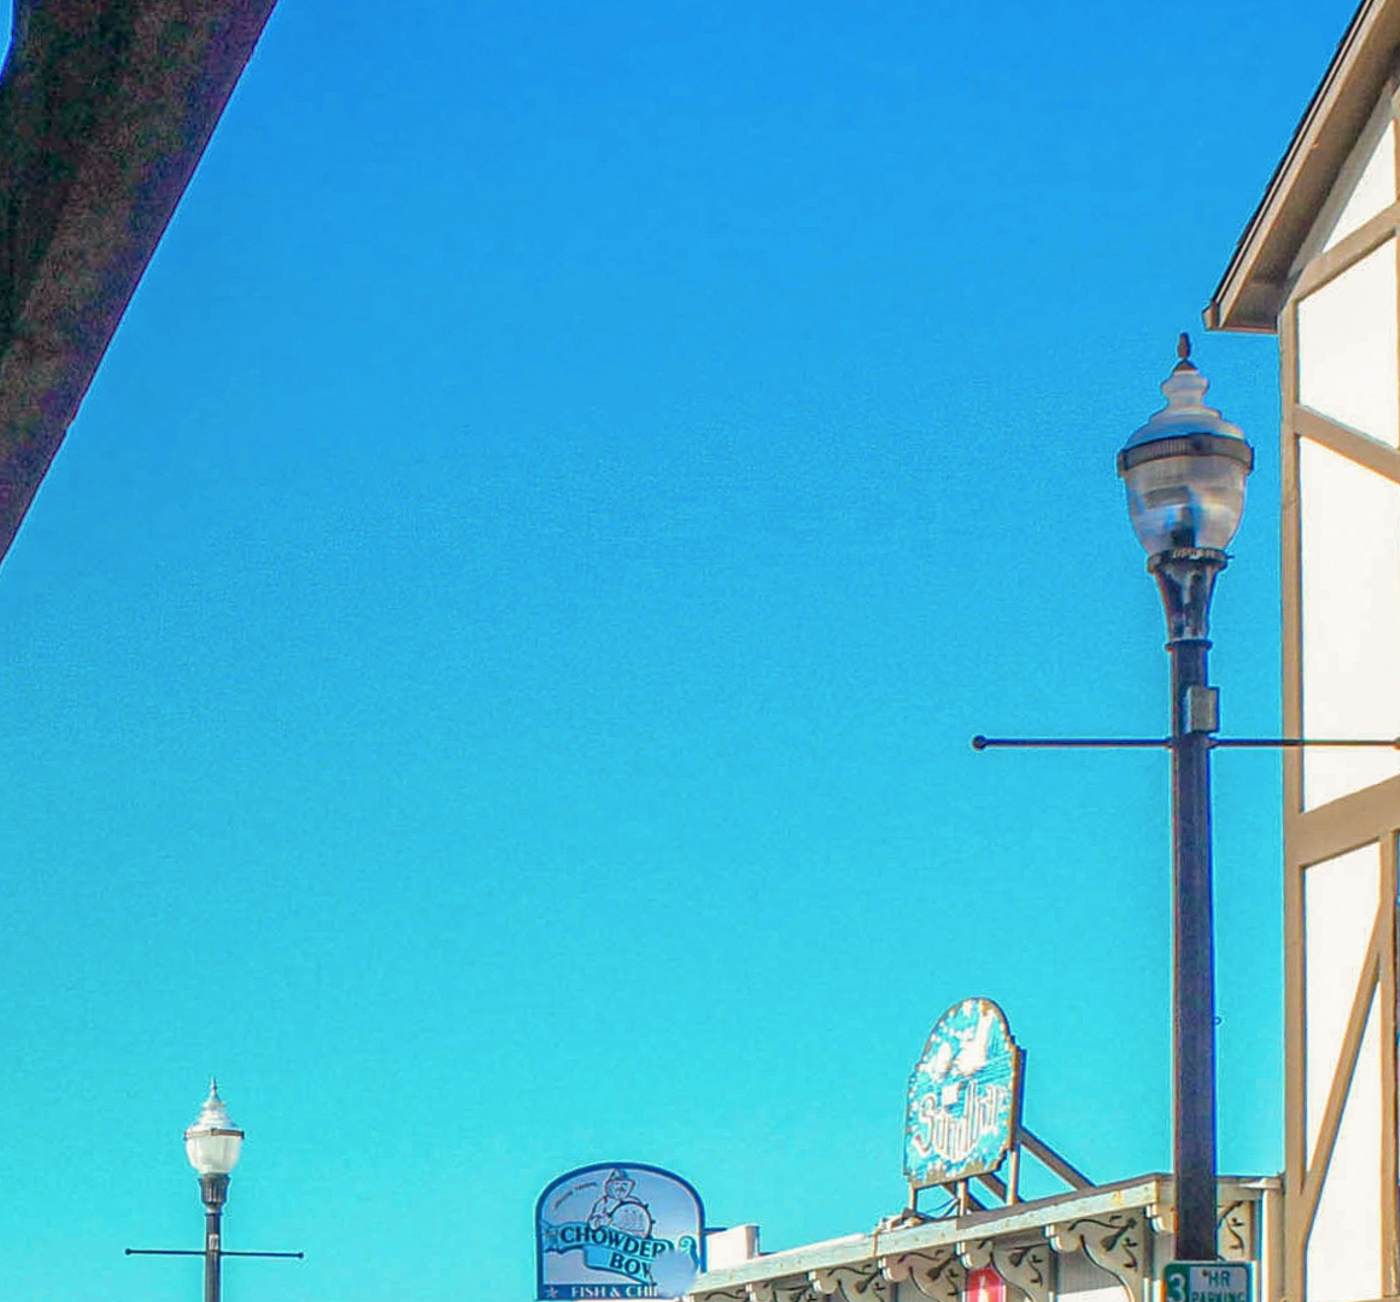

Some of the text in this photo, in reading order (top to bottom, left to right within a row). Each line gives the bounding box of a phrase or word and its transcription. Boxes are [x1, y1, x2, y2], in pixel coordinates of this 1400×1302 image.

[609, 1251, 652, 1280] BO
[1208, 1270, 1230, 1287] HR
[571, 1286, 603, 1298] FISH
[609, 1286, 620, 1298] &
